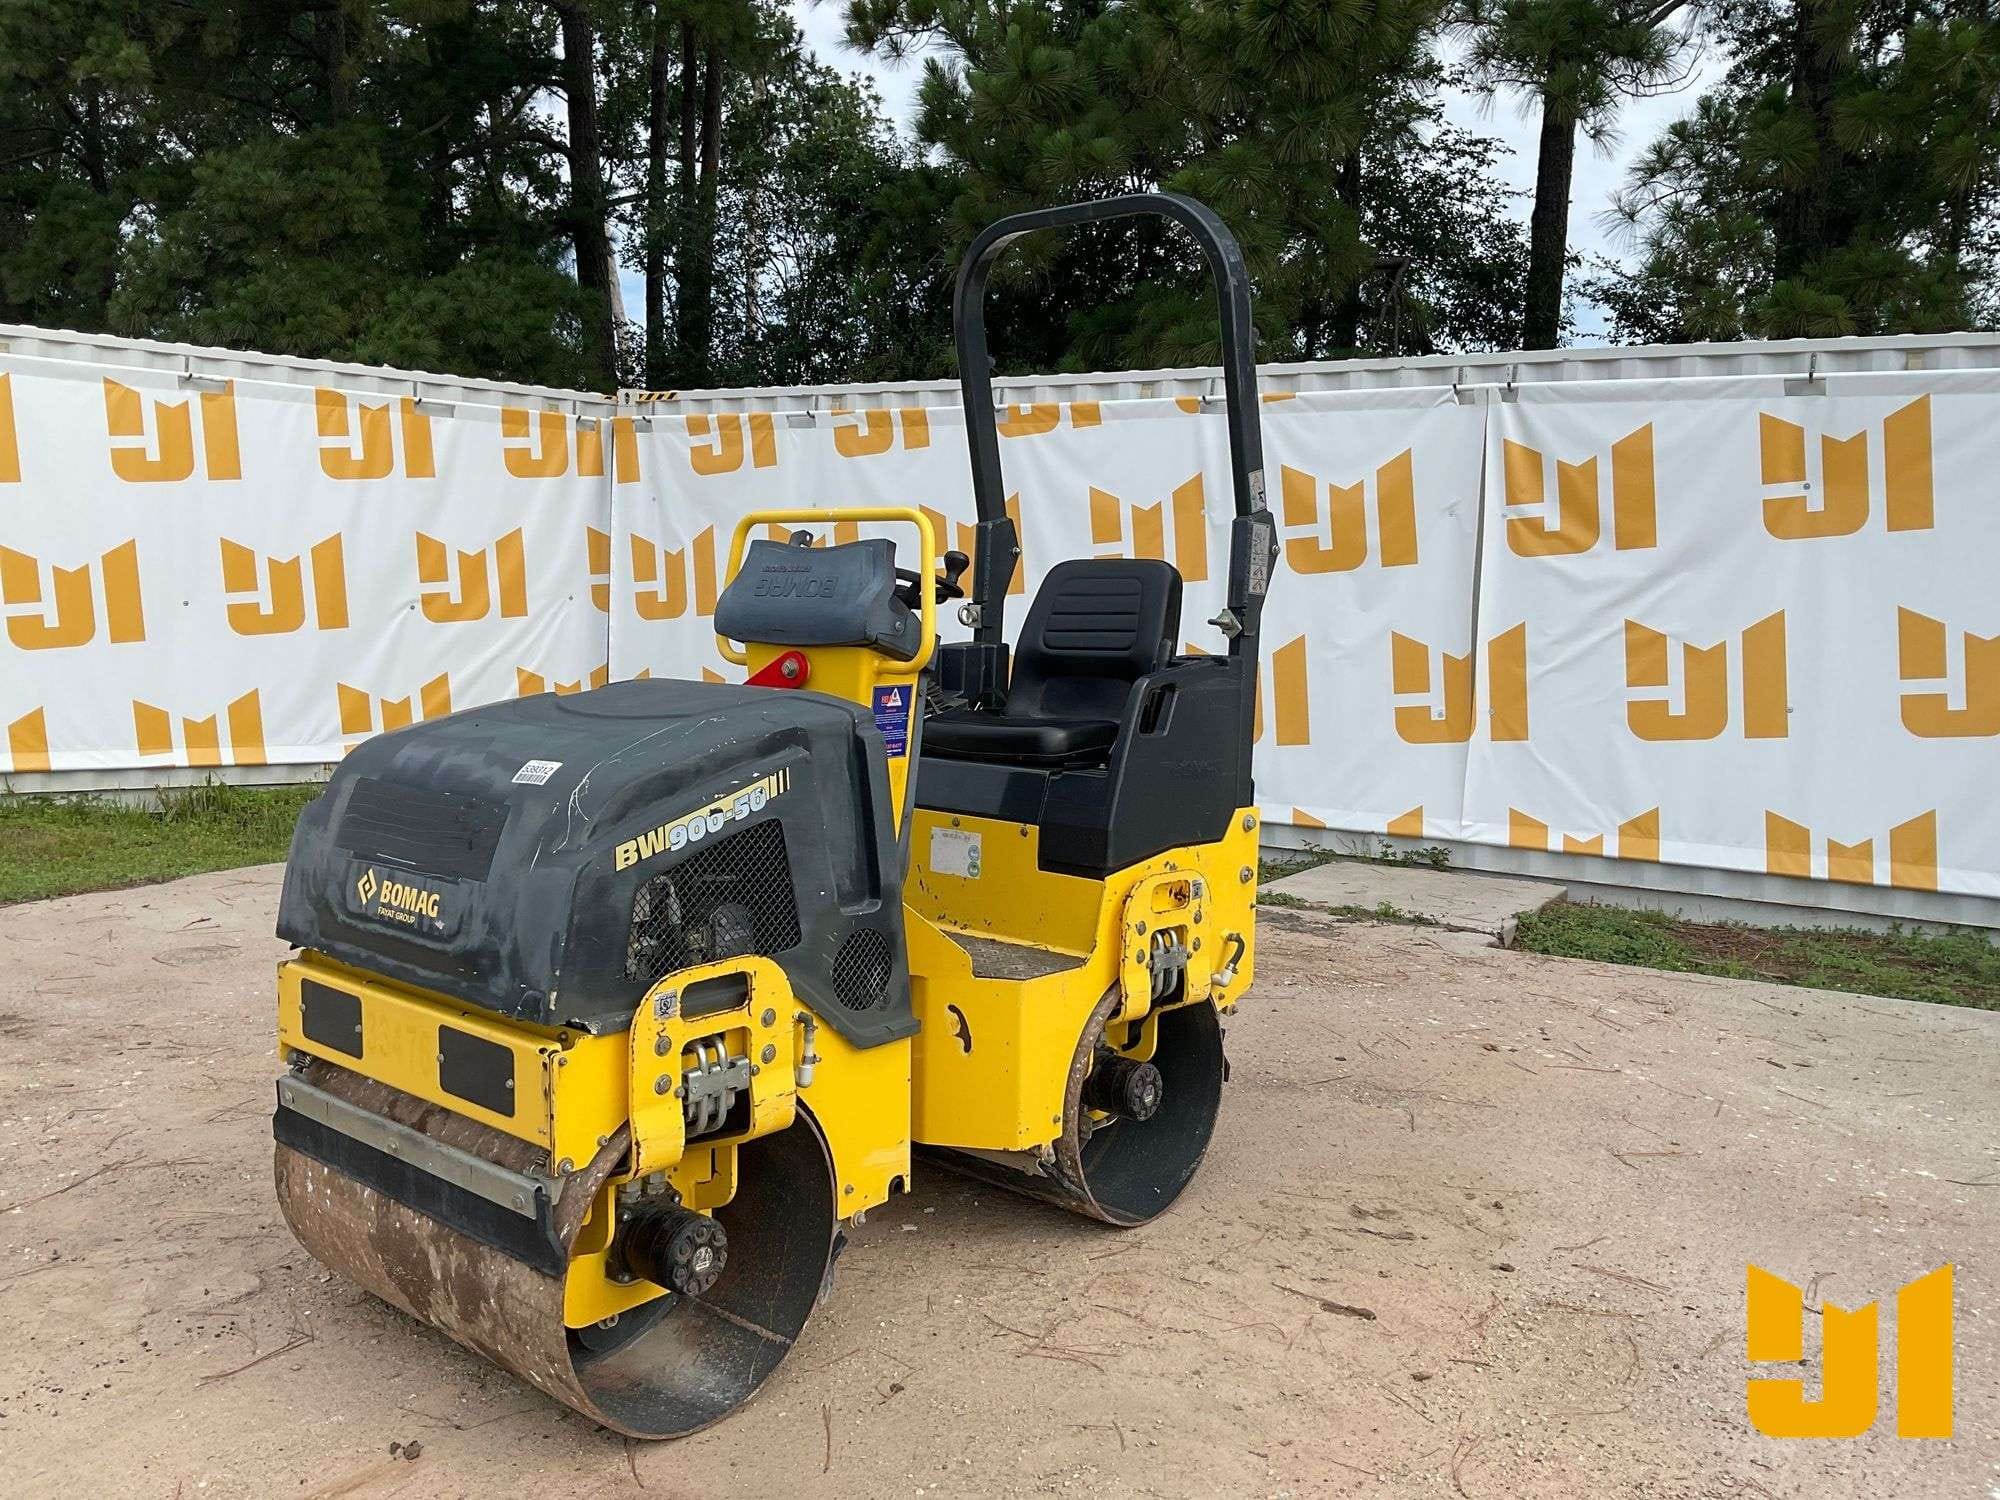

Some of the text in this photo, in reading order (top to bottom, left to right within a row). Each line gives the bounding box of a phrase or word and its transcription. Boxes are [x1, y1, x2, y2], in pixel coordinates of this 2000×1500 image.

[380, 880, 440, 918] BOMAG
[377, 906, 416, 924] FAYAT GROUP
